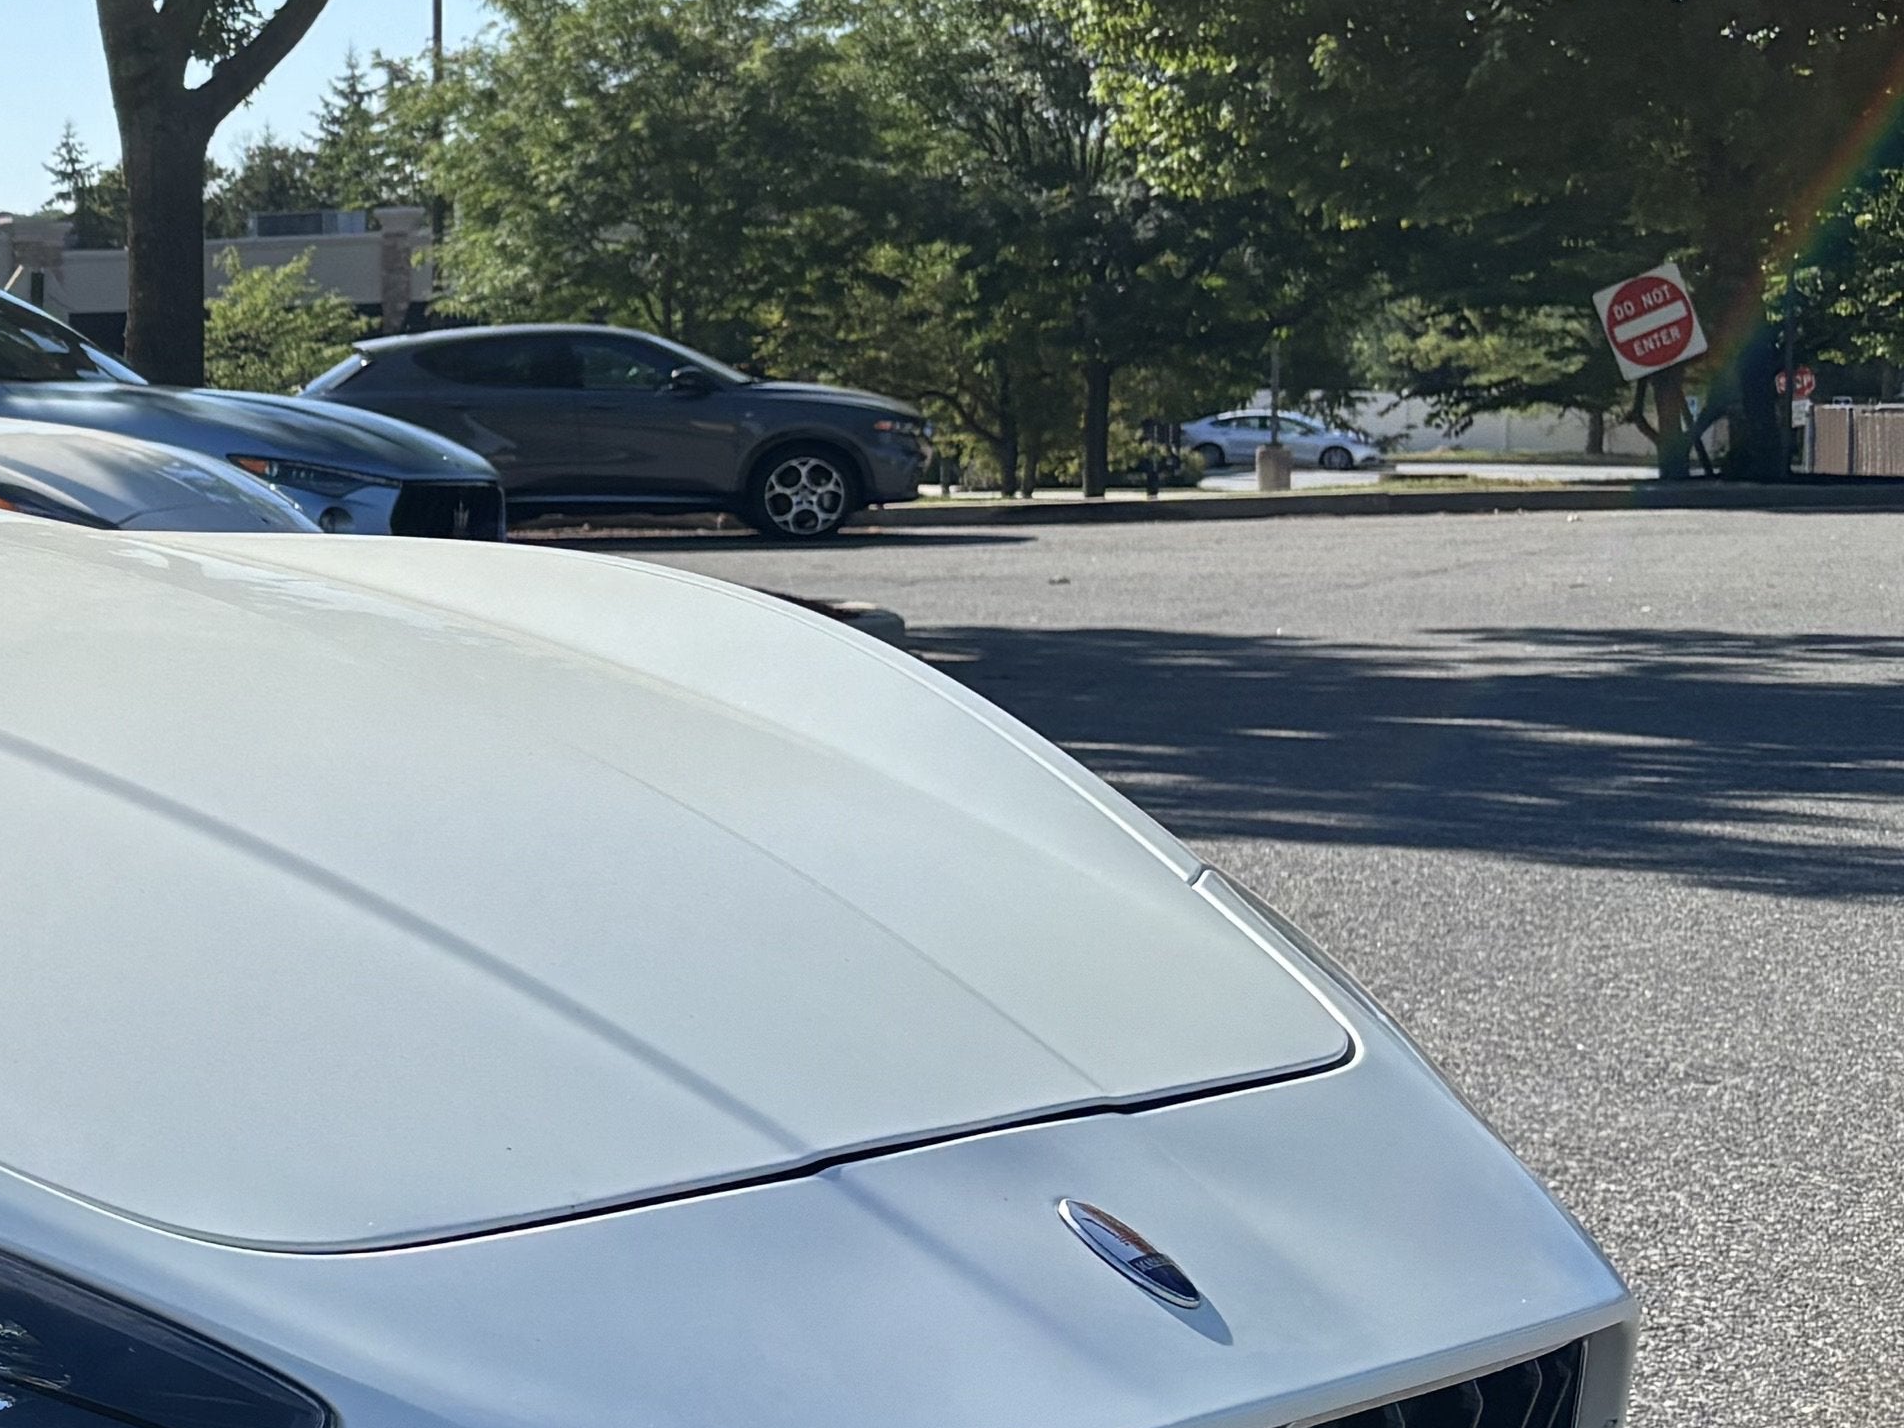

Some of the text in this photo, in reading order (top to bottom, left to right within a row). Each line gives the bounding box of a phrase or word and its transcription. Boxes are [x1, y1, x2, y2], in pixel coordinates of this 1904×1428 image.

[1613, 284, 1670, 321] DO NOT
[1633, 325, 1681, 357] ENTER
